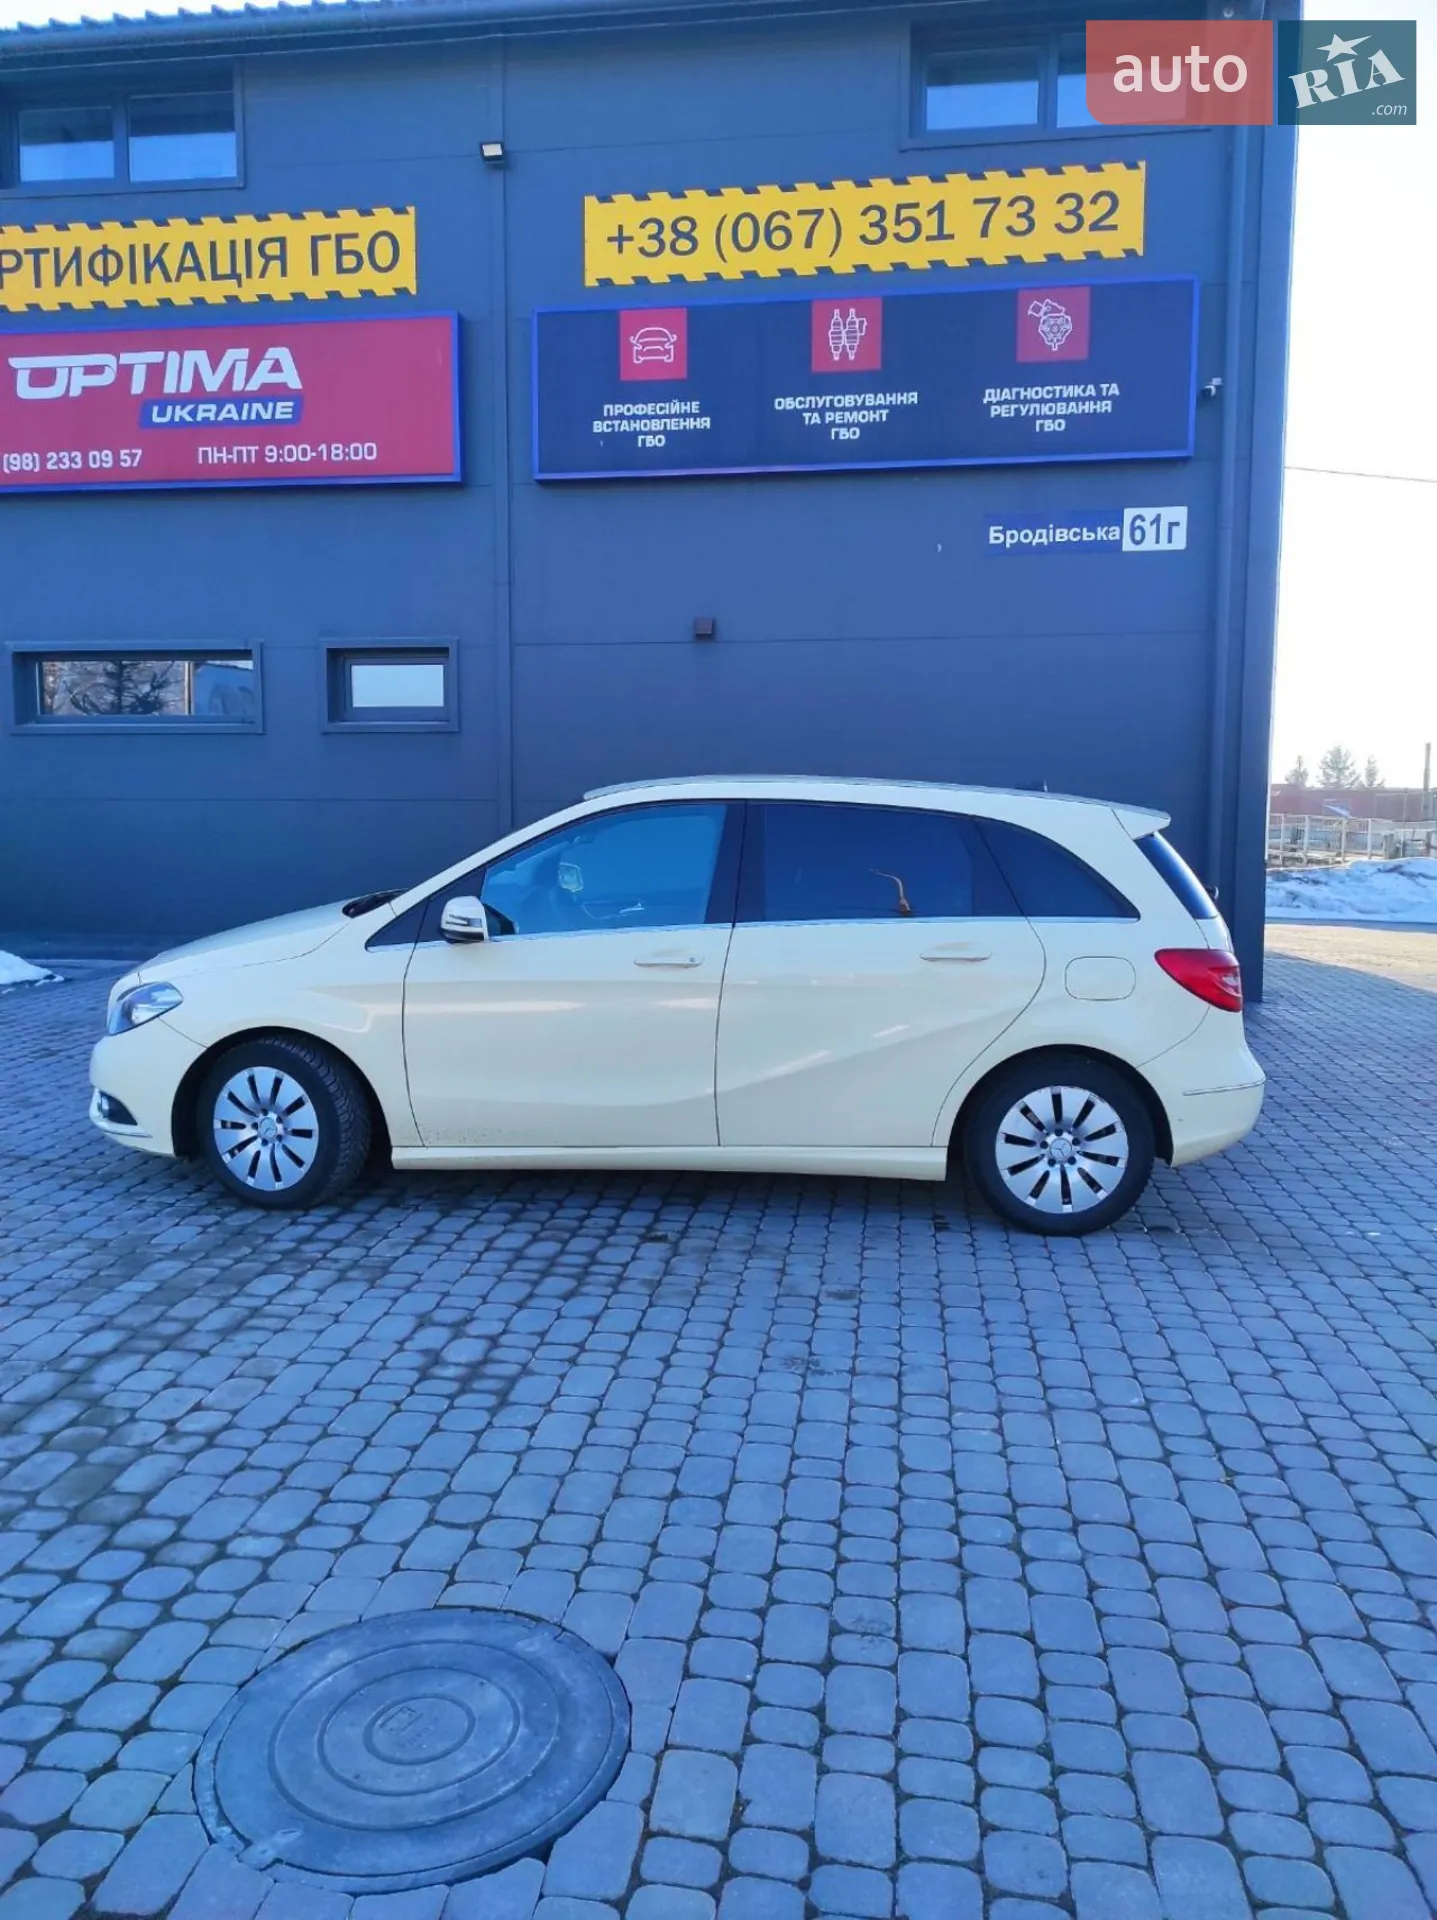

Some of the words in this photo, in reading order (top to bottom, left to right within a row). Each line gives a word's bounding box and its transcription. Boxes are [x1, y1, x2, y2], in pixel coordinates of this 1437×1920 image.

[607, 216, 699, 259] +38
[714, 207, 844, 262] (067)
[859, 200, 955, 246] 351
[973, 196, 1037, 239] 73
[1053, 190, 1121, 235] 32
[0, 236, 289, 290] РТИФІКАЦІЯ
[310, 230, 401, 277] ГБО
[8, 346, 304, 400] OPTIMA
[773, 391, 919, 410] ОБСЛУГОВУВАННЯ
[982, 384, 1097, 404] ДІАГНОСТИКА
[1099, 383, 1120, 397] ТА
[151, 401, 294, 424] UKRAINE
[603, 399, 701, 417] ПРОФЕСІЙНЕ
[802, 412, 822, 425] ТА
[825, 409, 890, 424] РЕМОНТ
[989, 400, 1113, 418] РЕГУЛЮВАННЯ
[592, 417, 711, 433] ВСТАНОВЛЕННЯ
[830, 427, 861, 440] ГБО
[1035, 419, 1066, 432] ГБО
[637, 434, 666, 448] ГБО
[3, 452, 40, 473] (98)
[46, 451, 83, 470] 233
[88, 449, 114, 468] 09
[119, 449, 143, 467] 57
[198, 446, 260, 464] ПН-ПТ
[264, 442, 378, 463] 9:00-18:00
[988, 524, 1121, 548] Бродівська
[1128, 513, 1180, 546] 61г
